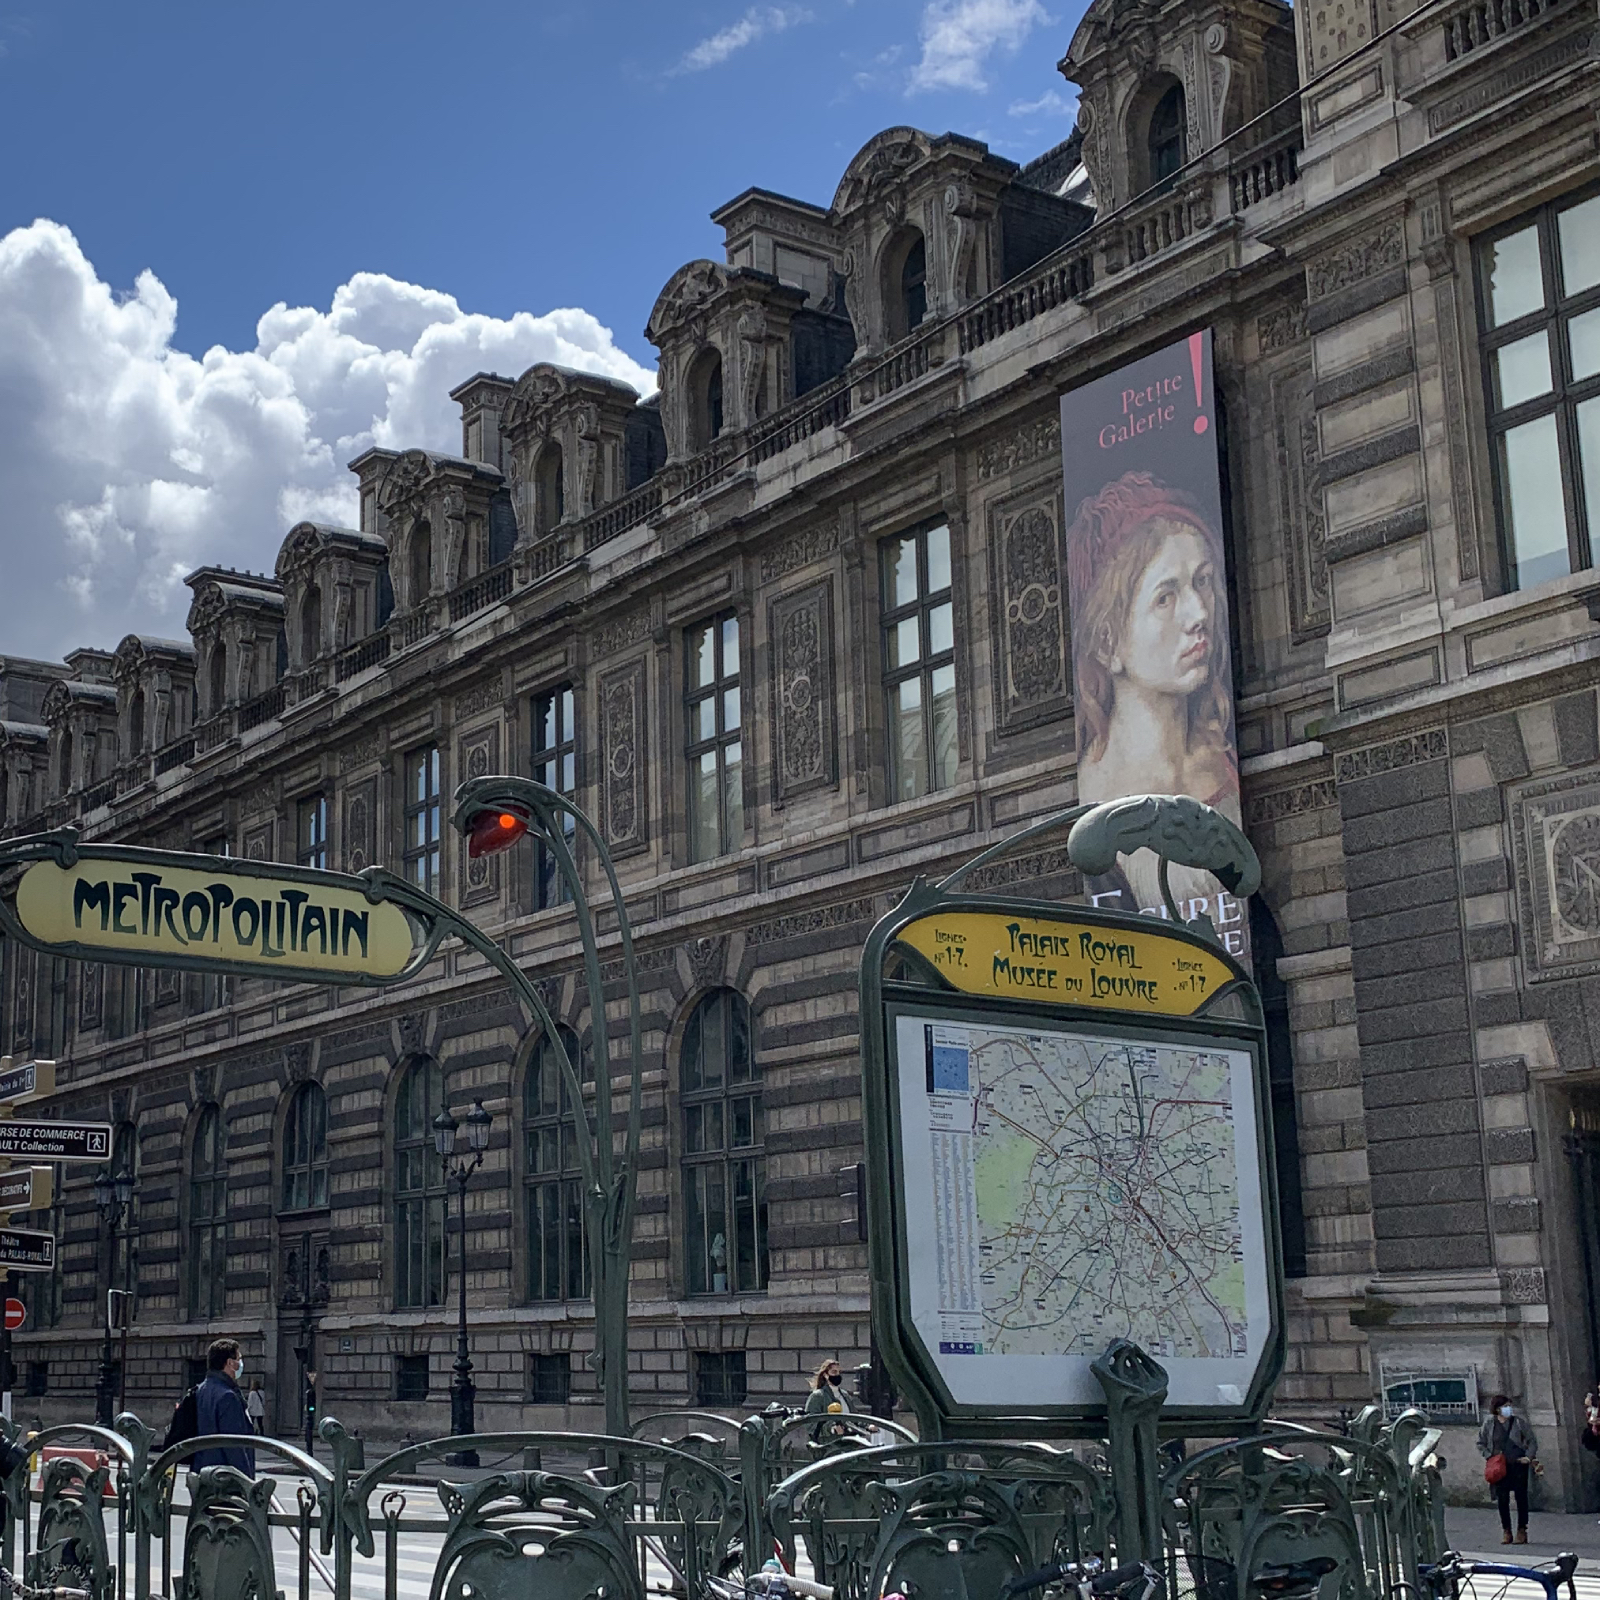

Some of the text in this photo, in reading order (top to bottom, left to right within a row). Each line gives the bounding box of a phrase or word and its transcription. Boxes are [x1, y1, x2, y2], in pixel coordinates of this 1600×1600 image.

[73, 872, 370, 959] METROPOLITAIN
[1078, 931, 1143, 969] ROYAL
[19, 1128, 32, 1138] DE
[33, 1128, 86, 1140] COMMERCE
[20, 1140, 65, 1152] Collection
